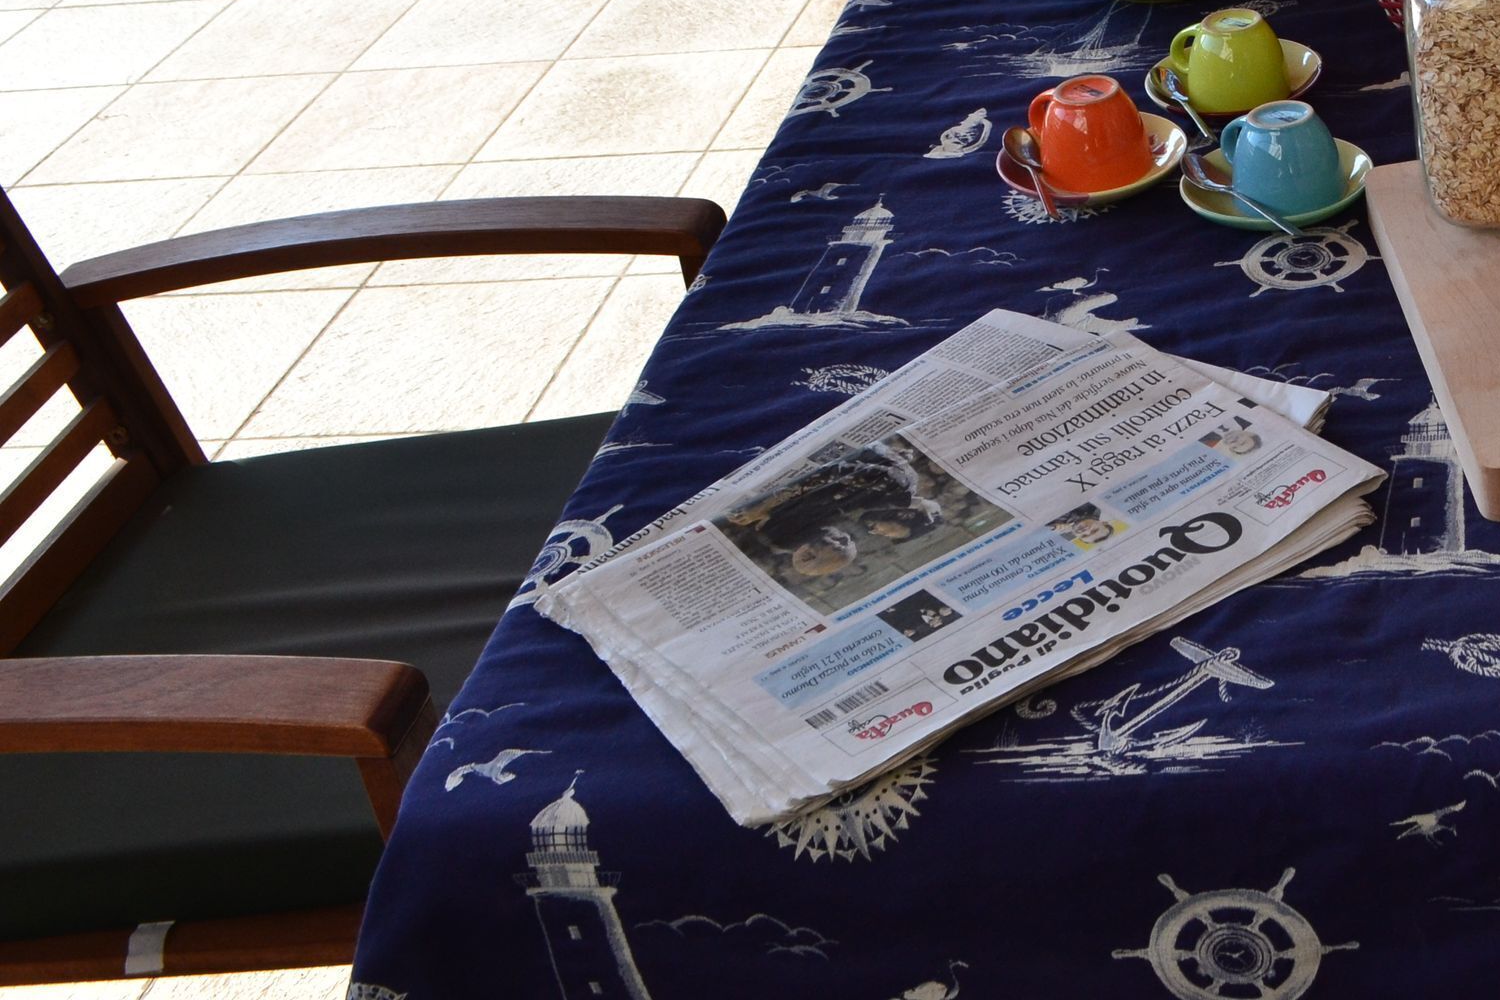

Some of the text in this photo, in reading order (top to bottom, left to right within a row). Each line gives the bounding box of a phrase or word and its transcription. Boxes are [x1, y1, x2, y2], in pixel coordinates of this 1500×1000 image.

[964, 352, 1133, 442] Il primario: lo stent non era scaduto
[1140, 369, 1172, 385] in
[955, 359, 1147, 467] Nuove verifiche dei Nas dopo i sequestri
[1017, 382, 1144, 456] rianimazione
[1163, 401, 1225, 439] Fazzi
[997, 387, 1191, 498] controlli sui farmaci
[1088, 445, 1145, 479] raggi
[1141, 433, 1166, 452] ai
[1065, 472, 1097, 493] X
[1127, 458, 1221, 514] Salvemini apre la sfida
[1147, 477, 1163, 490] più
[1168, 463, 1190, 478] forti
[1264, 469, 1326, 509] Quarta
[650, 508, 687, 530] bad
[957, 539, 1054, 594] il piano da 100 milioni
[962, 545, 1067, 602] Xylella, Centinaio firma
[1138, 556, 1200, 595] NUOVO
[943, 512, 1242, 684] Quotidiano
[1002, 569, 1093, 621] Lecce
[764, 635, 806, 659] L'ANALISI
[781, 636, 895, 698] Il Volo in piazza Duomo
[790, 629, 882, 680] concerto il 21 luglio
[960, 639, 1057, 695] di Puglia
[855, 701, 933, 739] Quarta
